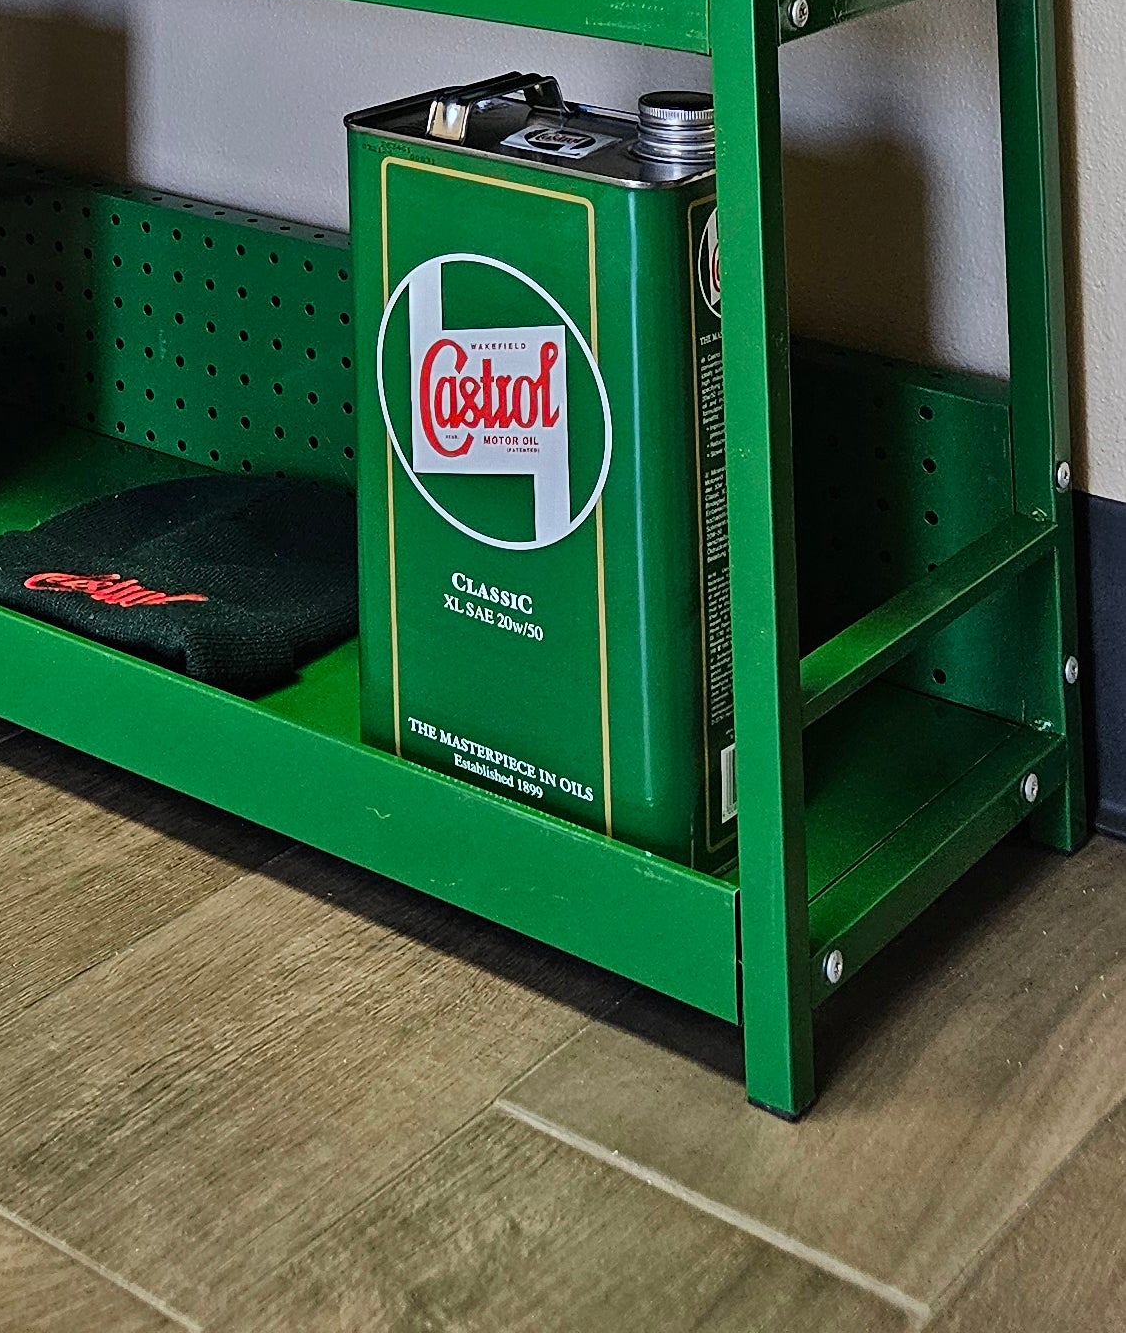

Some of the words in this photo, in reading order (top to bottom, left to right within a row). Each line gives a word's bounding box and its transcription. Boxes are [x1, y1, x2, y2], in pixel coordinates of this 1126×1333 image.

[471, 342, 526, 350] WAKEFIELD
[419, 338, 560, 458] Castrol
[483, 436, 519, 445] MOTOR
[522, 436, 539, 446] OIL
[443, 593, 464, 614] XL
[465, 601, 495, 625] SAE
[497, 612, 544, 642] 20w/50
[408, 717, 437, 741] THE
[439, 729, 536, 779] MASTERPIECE
[539, 768, 557, 788] IN
[559, 777, 595, 802] OILS
[454, 753, 515, 788] Established
[517, 778, 544, 799] 1899
